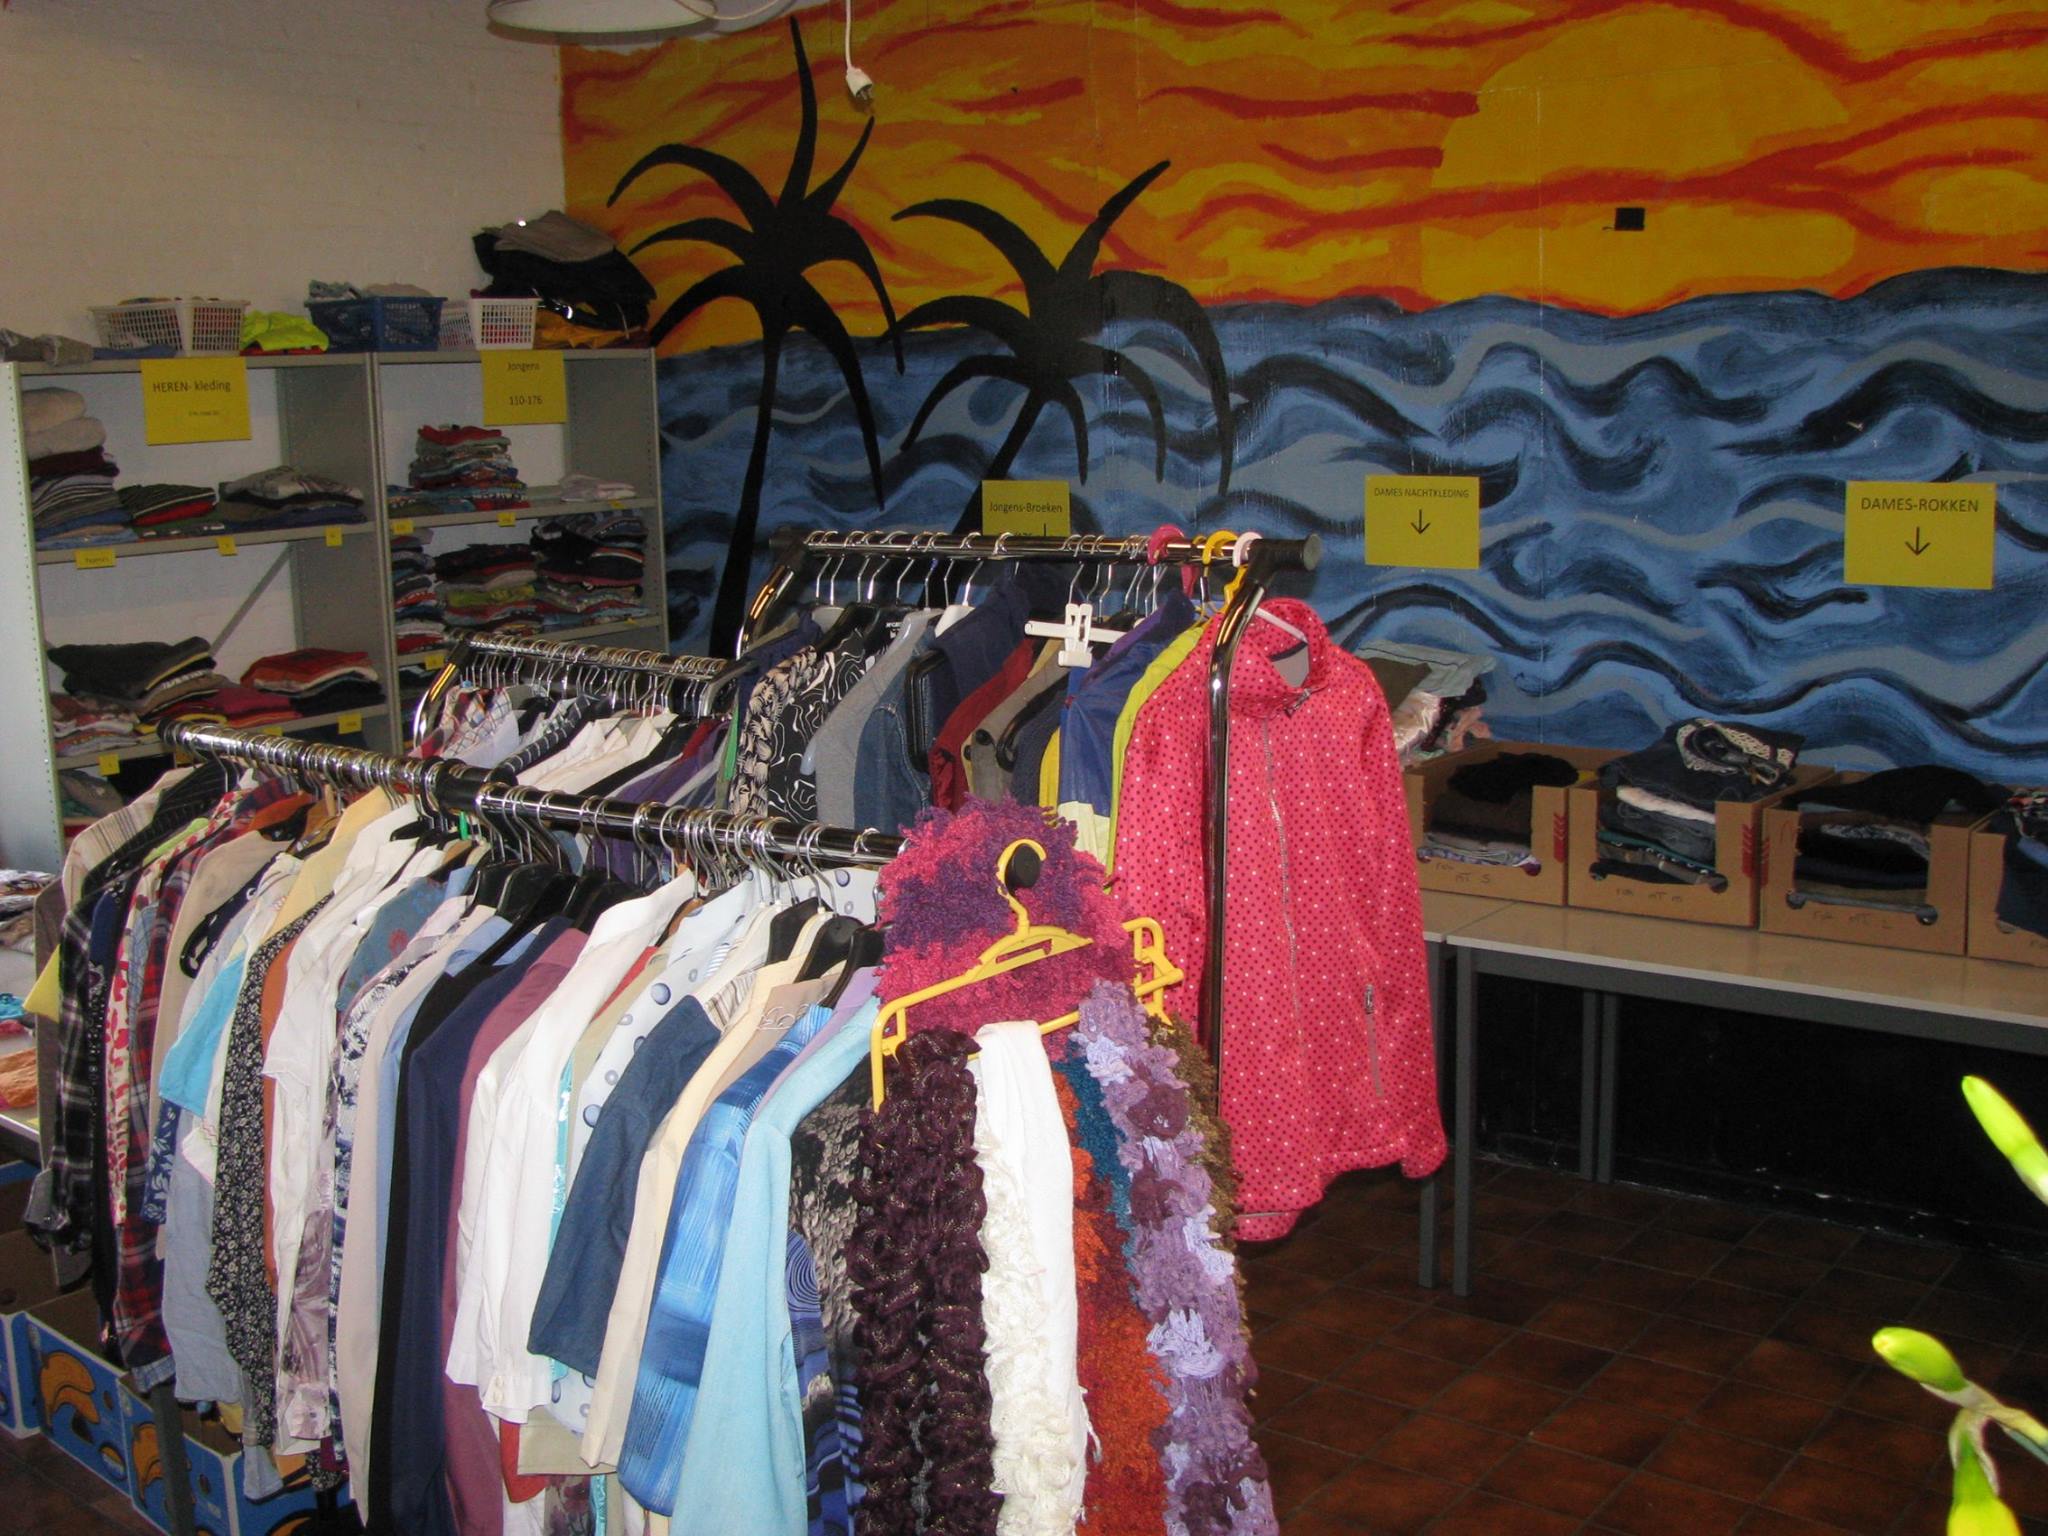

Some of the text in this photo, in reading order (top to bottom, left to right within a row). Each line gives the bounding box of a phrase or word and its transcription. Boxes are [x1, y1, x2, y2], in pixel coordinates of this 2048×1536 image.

[507, 362, 541, 373] Jongens
[194, 379, 231, 393] kleding
[990, 501, 1063, 514] Jongens-Broeken
[1861, 497, 1980, 512] DAMES-ROKKEN
